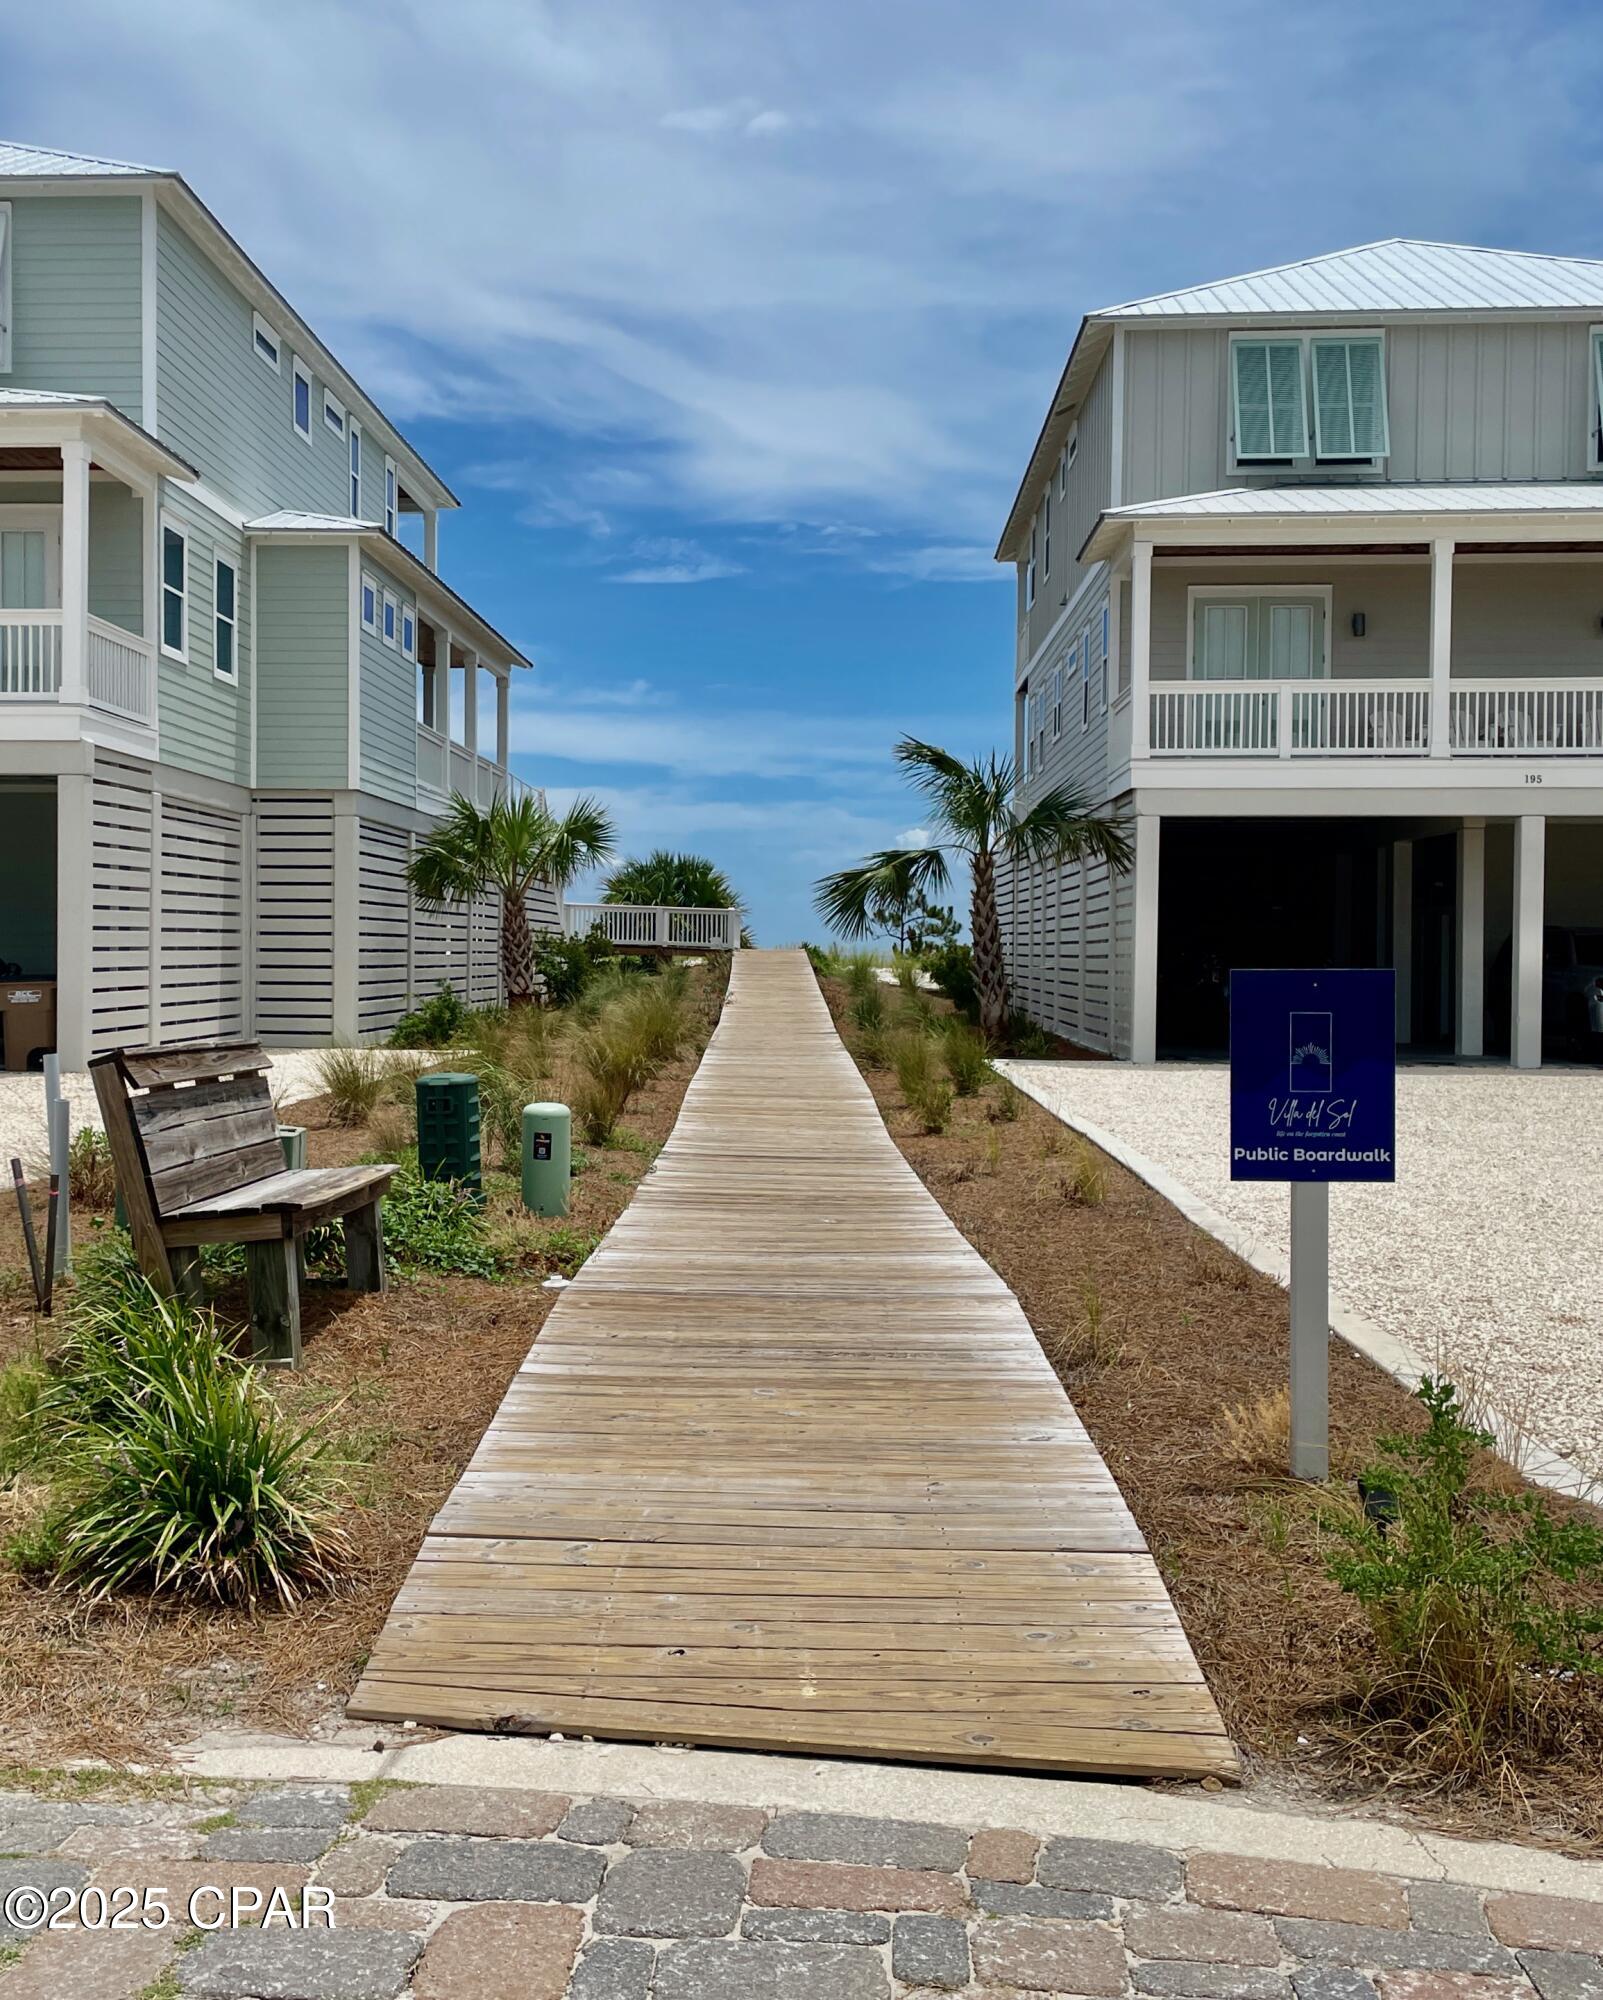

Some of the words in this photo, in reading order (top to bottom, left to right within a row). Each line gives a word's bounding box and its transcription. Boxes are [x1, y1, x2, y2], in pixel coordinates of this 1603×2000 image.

[1525, 774, 1542, 784] 195
[1268, 1098, 1304, 1127] Villa
[1305, 1099, 1325, 1128] del
[1327, 1099, 1357, 1130] Sol
[1234, 1147, 1289, 1161] Public
[1293, 1148, 1391, 1162] Boardwalk
